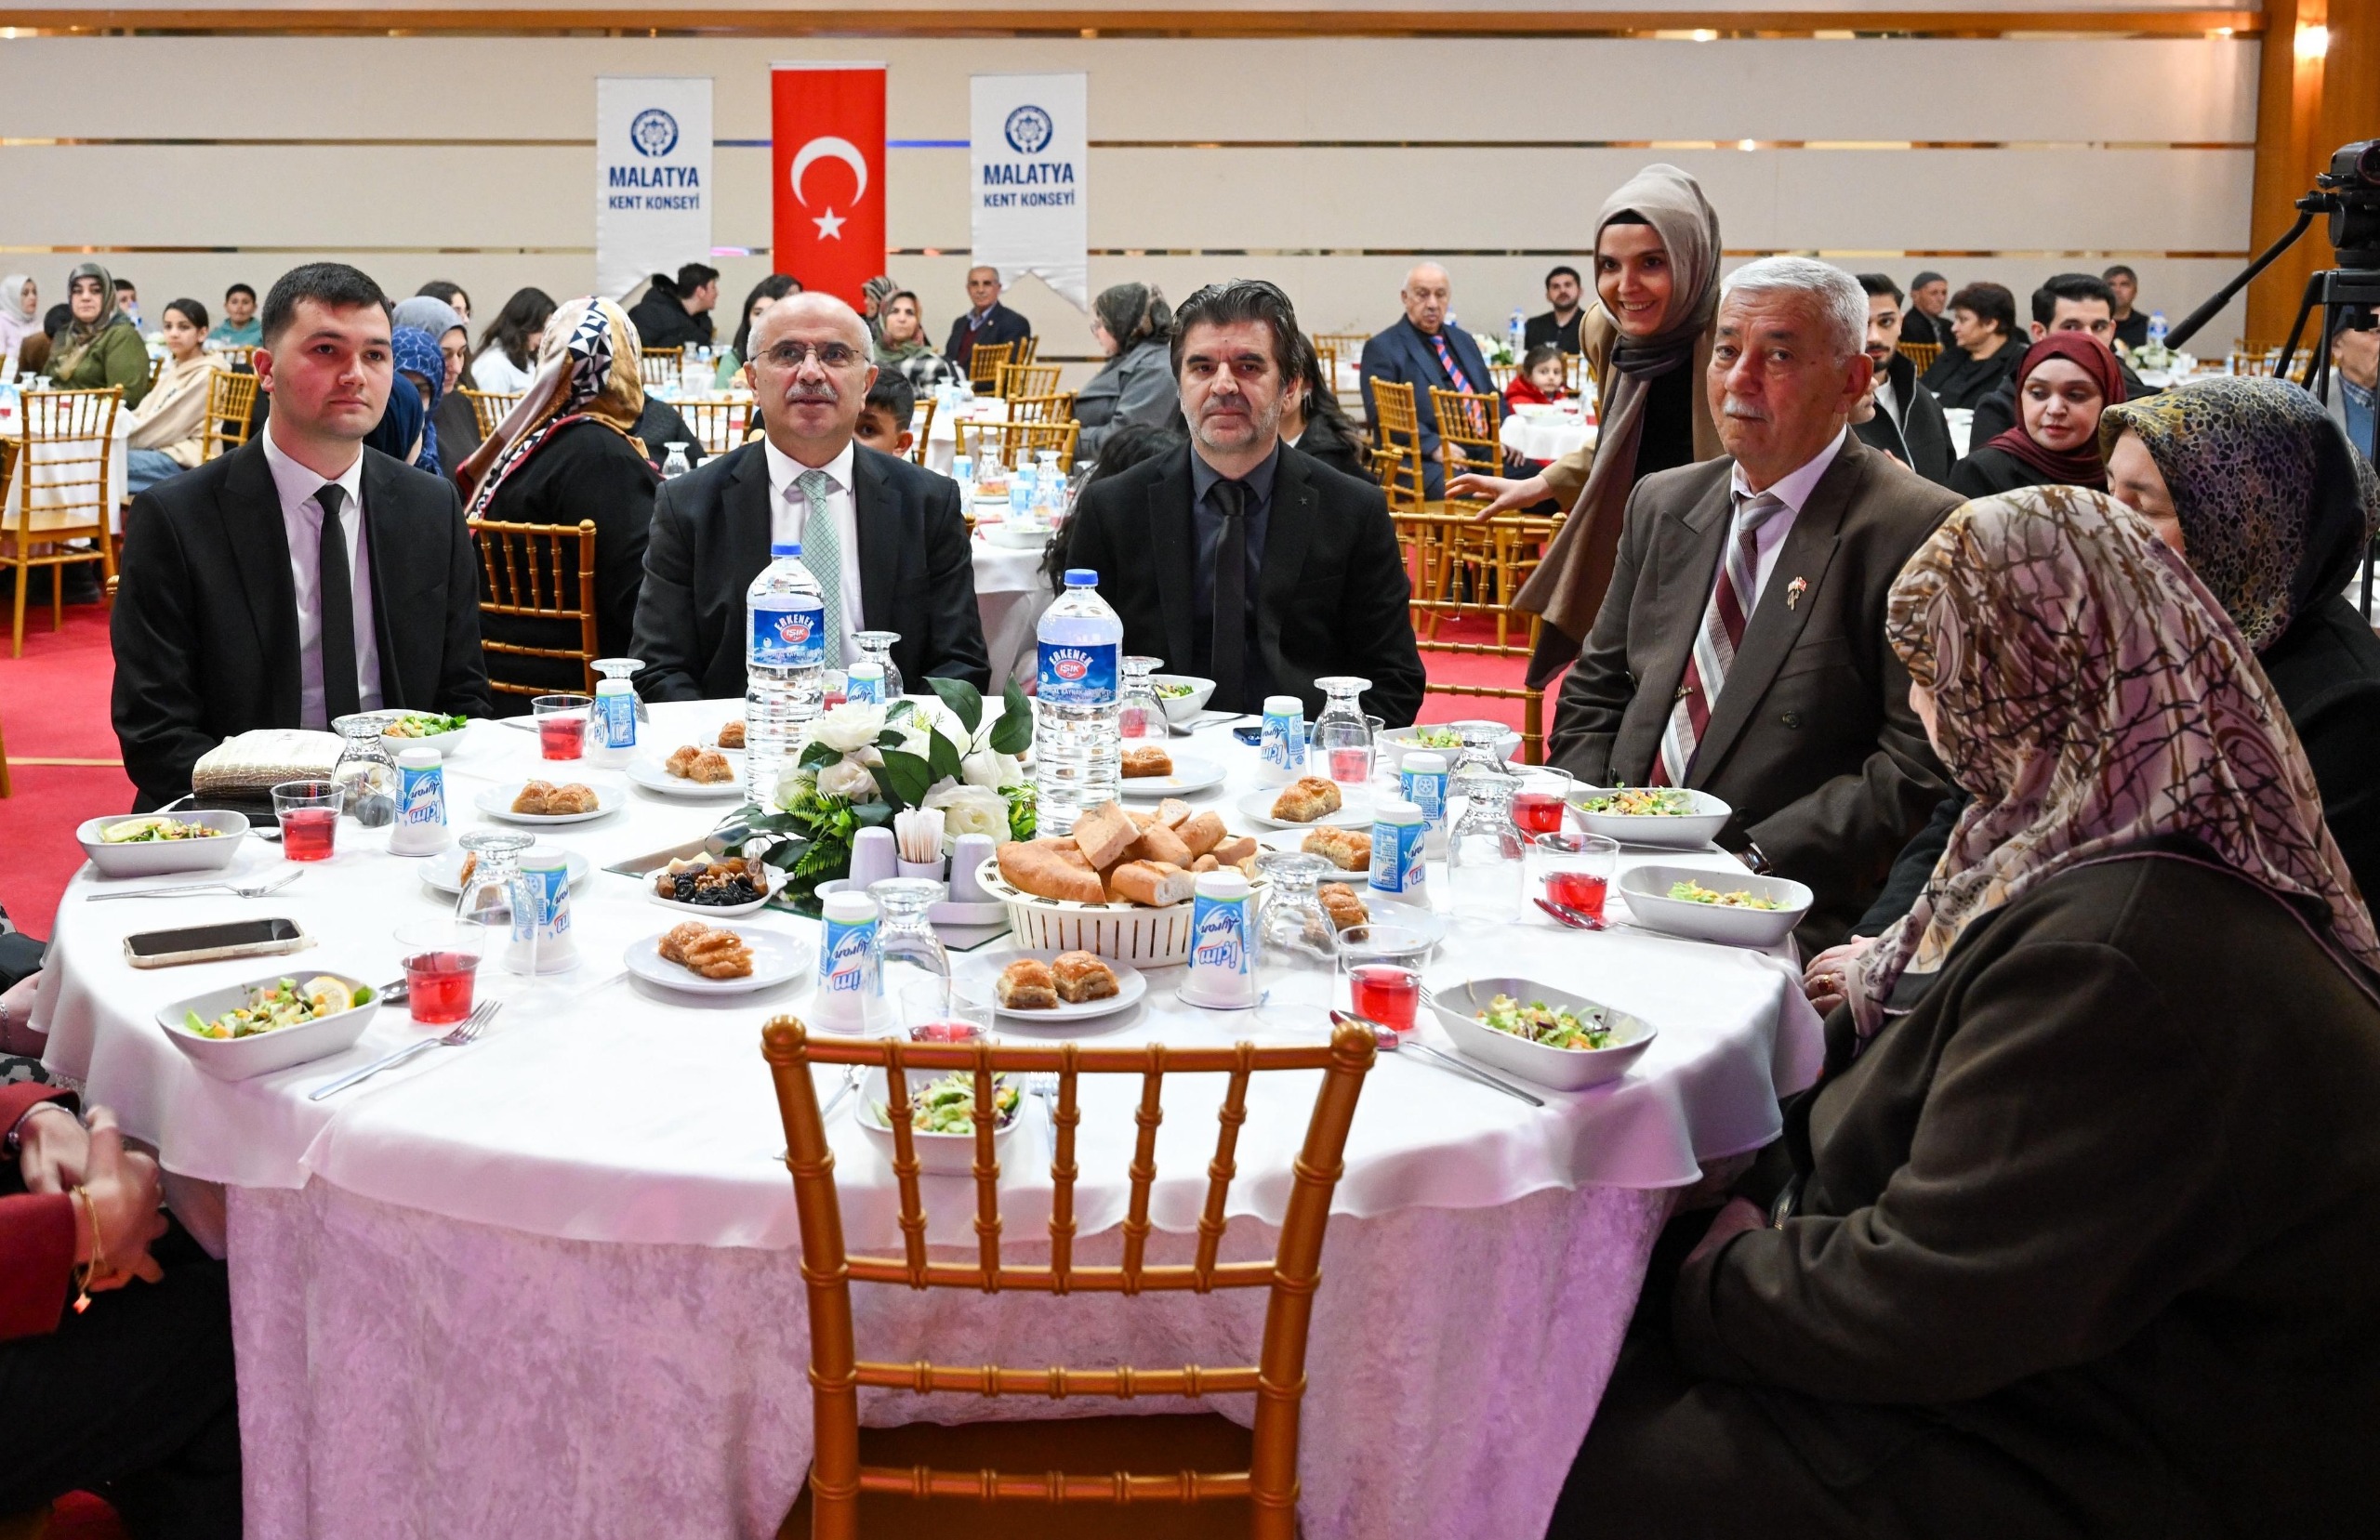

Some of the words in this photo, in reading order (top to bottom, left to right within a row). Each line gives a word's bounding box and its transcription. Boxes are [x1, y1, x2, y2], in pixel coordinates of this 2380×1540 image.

[610, 167, 699, 187] MALATYA
[984, 164, 1074, 185] MALATYA
[609, 196, 641, 209] KENT
[646, 193, 699, 209] KONSEYİ
[984, 192, 1016, 206] KENT
[1021, 189, 1075, 206] KONSEYİ
[774, 614, 814, 631] ERKENEK
[1049, 649, 1094, 667] ERKENEK
[410, 780, 441, 799] Ayran
[410, 800, 441, 824] İçim
[1200, 915, 1240, 934] Ayran
[1198, 941, 1237, 968] İçim
